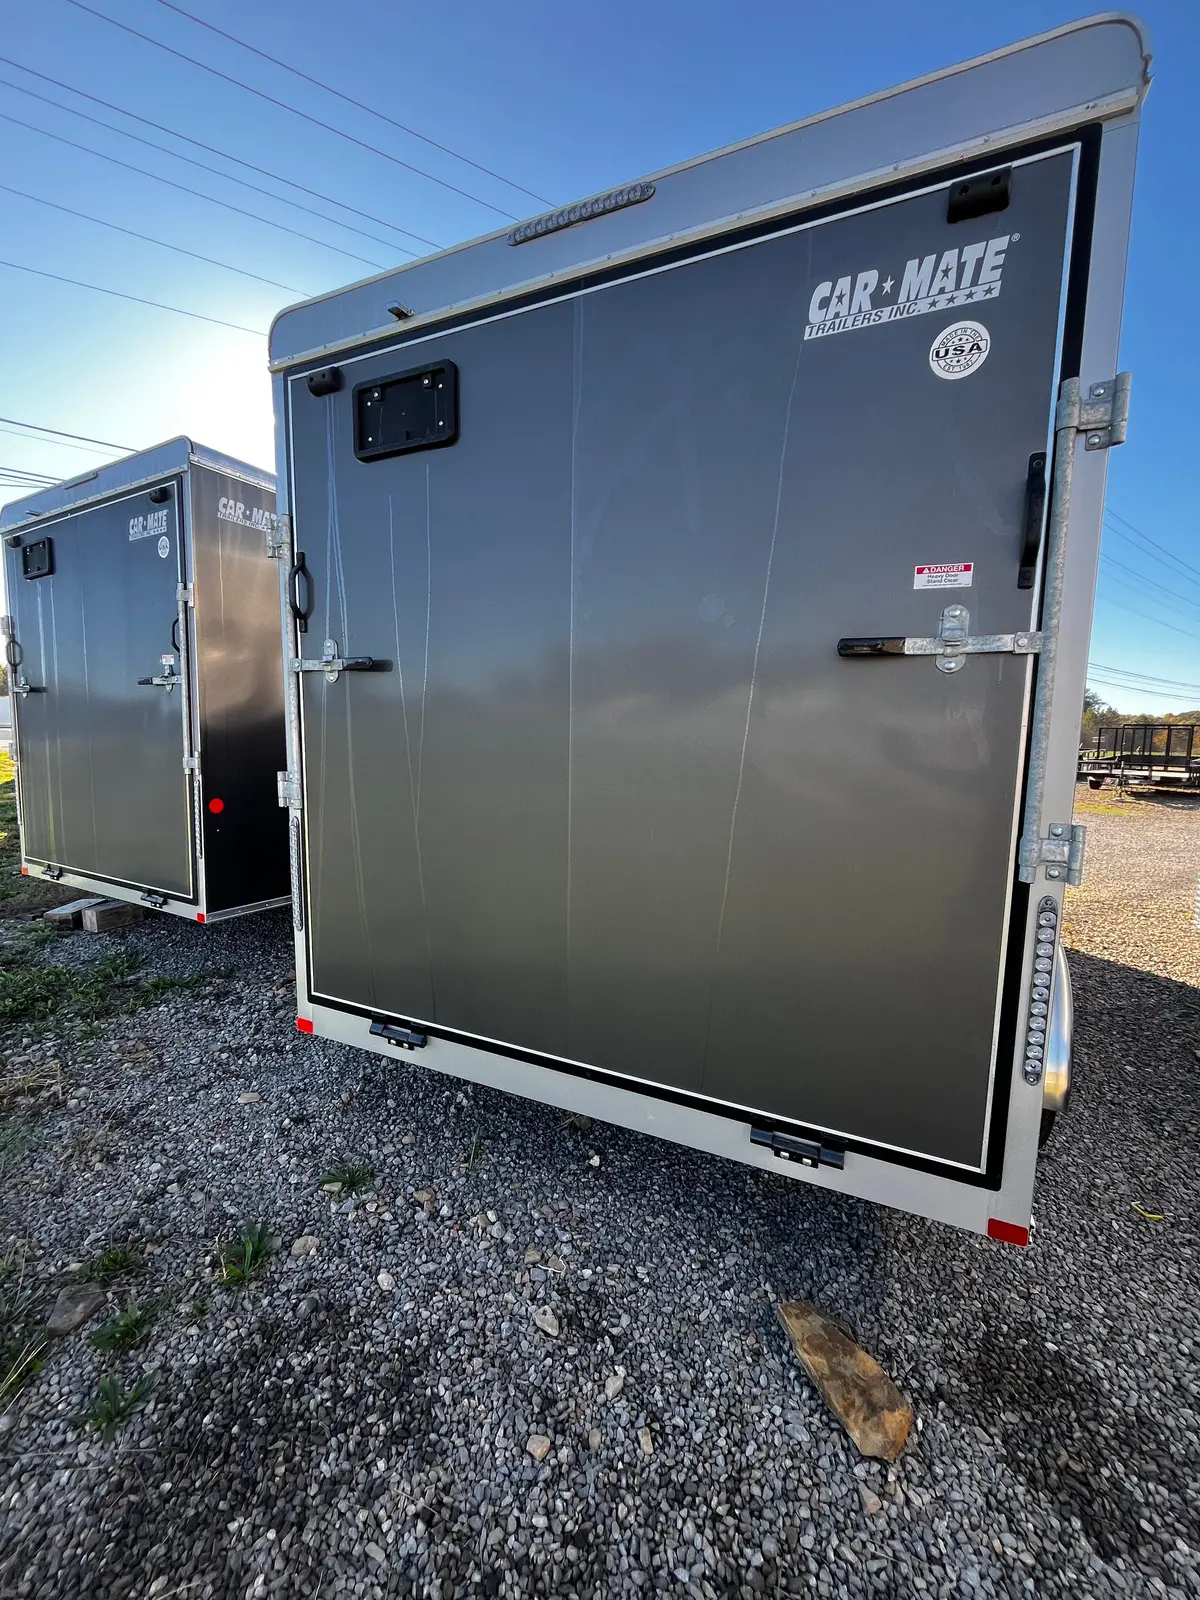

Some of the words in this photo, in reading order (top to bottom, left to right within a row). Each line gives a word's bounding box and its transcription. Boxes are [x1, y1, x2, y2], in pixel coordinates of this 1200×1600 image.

[808, 269, 879, 324] CAR
[898, 235, 1010, 303] MATE
[807, 310, 883, 338] TRAILERS
[888, 302, 921, 320] INC.
[935, 343, 982, 358] USA
[941, 330, 958, 347] MADE
[970, 329, 980, 340] THE
[129, 516, 143, 535] CAR
[147, 510, 167, 531] MATE
[219, 497, 245, 519] CAR
[252, 507, 277, 529] MAT
[930, 565, 965, 573] DANGER
